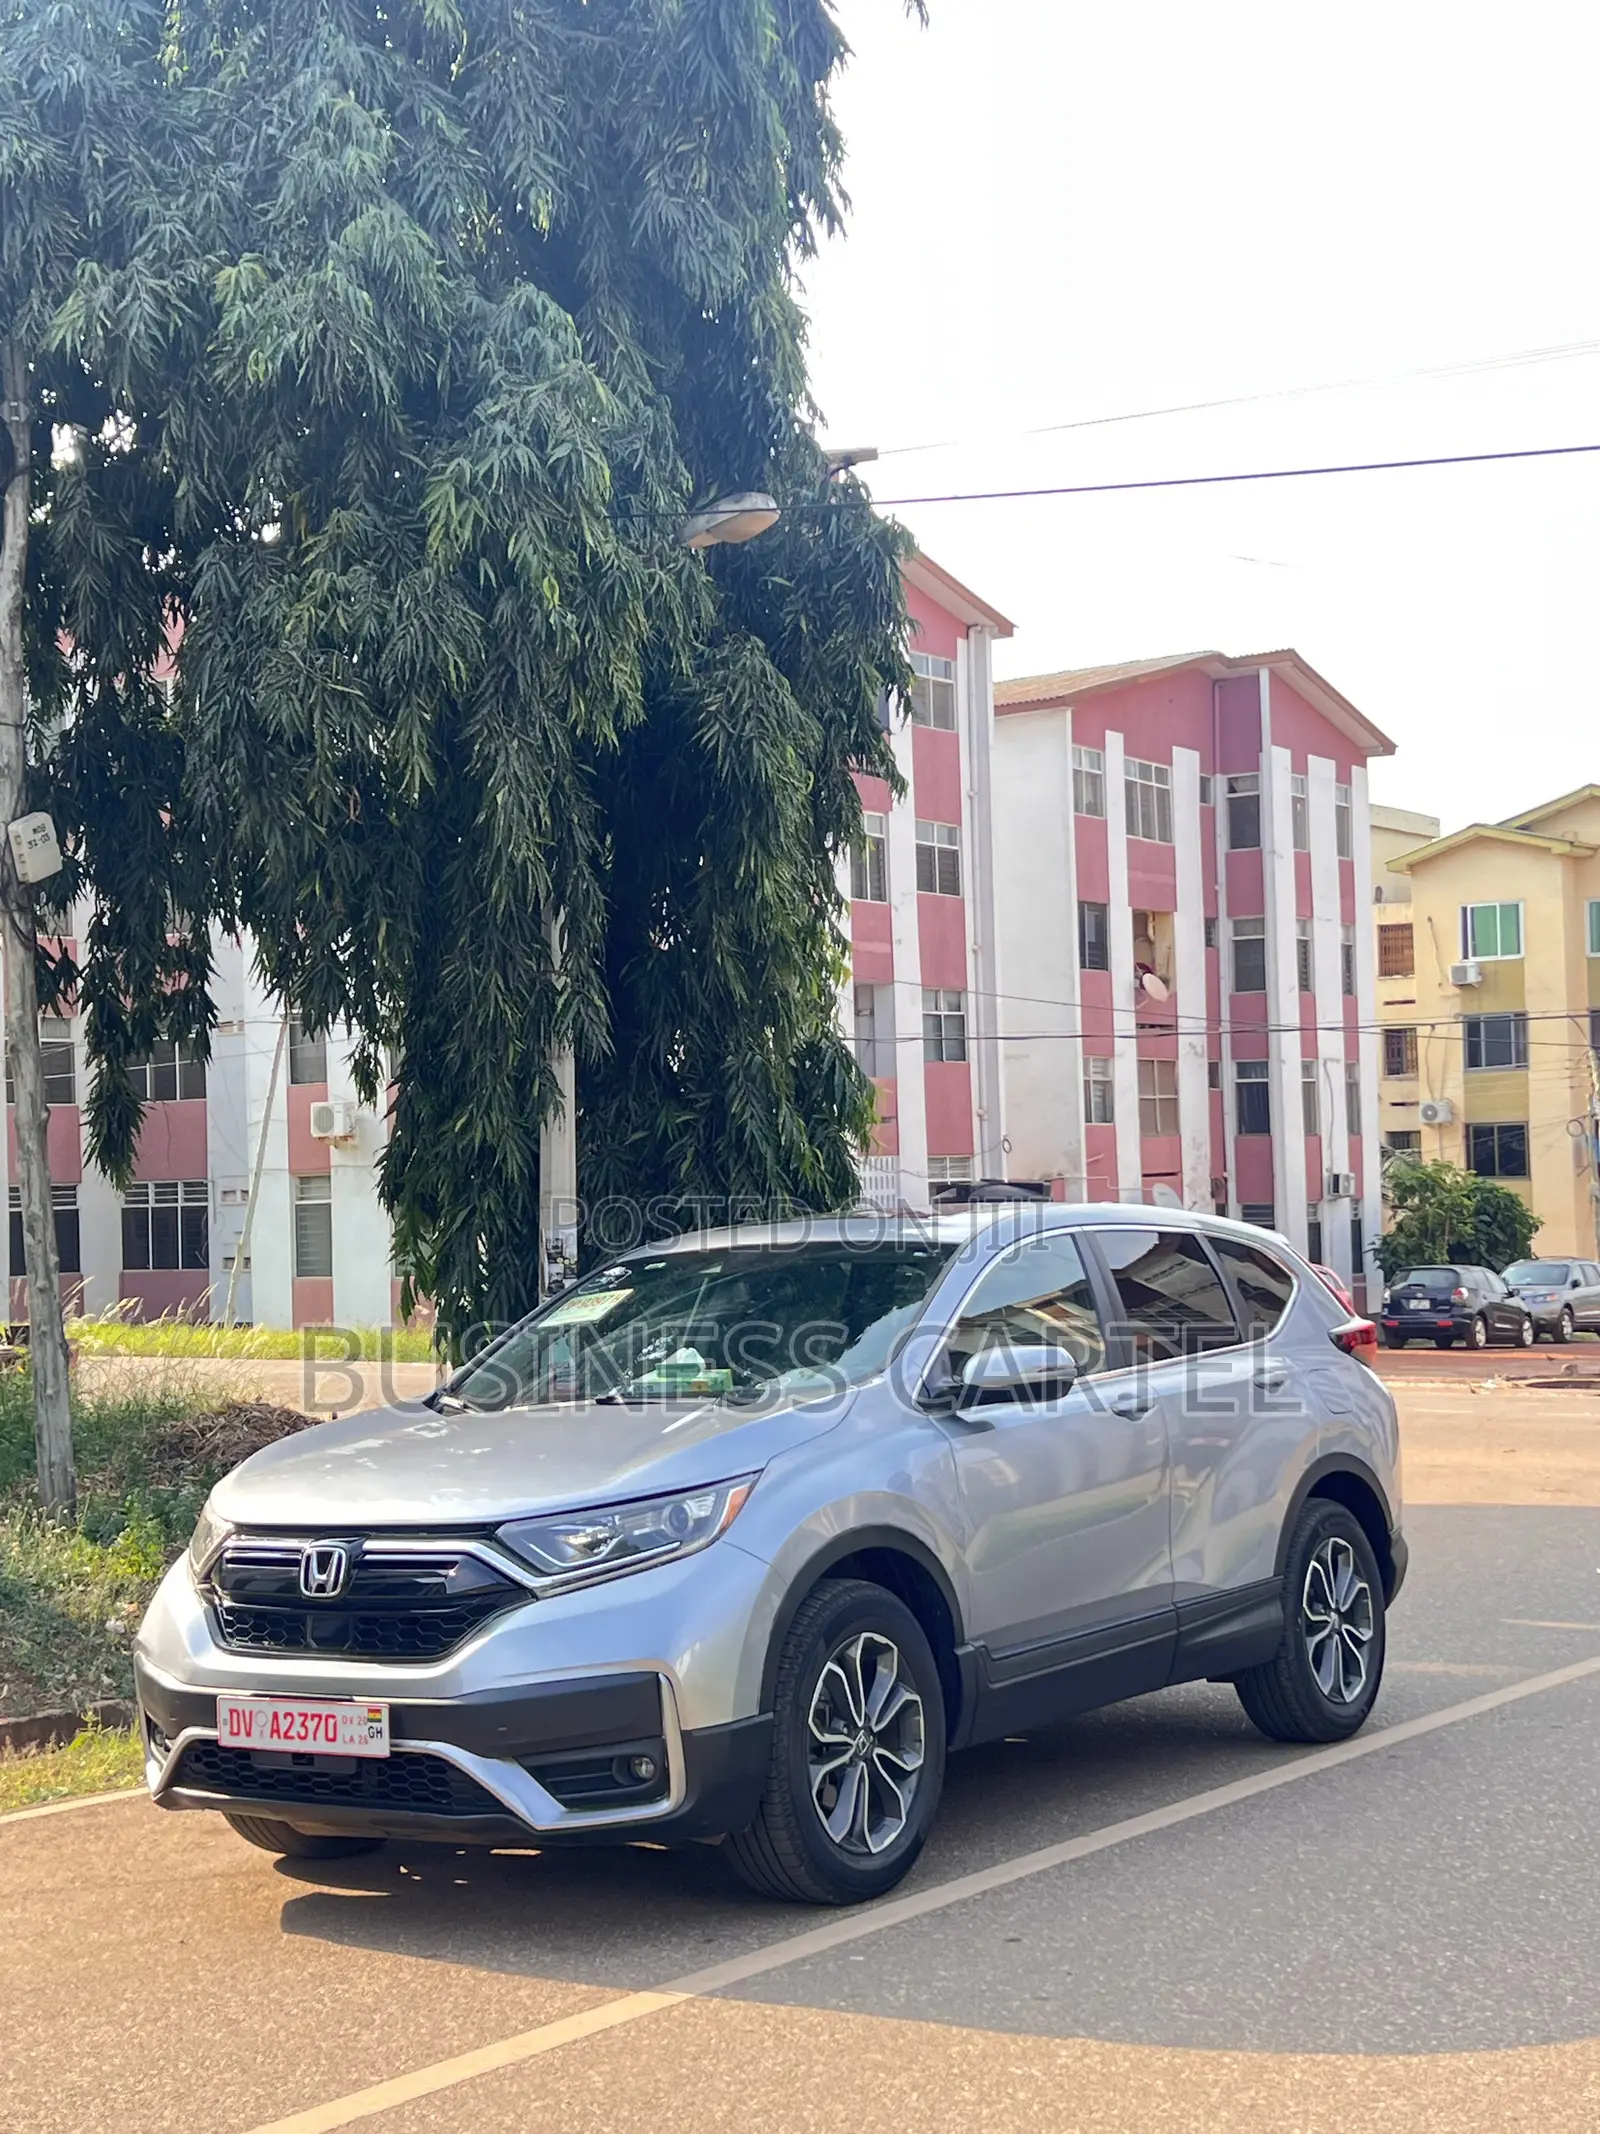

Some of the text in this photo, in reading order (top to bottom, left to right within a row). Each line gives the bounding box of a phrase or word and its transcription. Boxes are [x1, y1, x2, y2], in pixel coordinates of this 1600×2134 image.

[228, 1708, 337, 1743] DV A2370
[368, 1725, 383, 1739] GH
